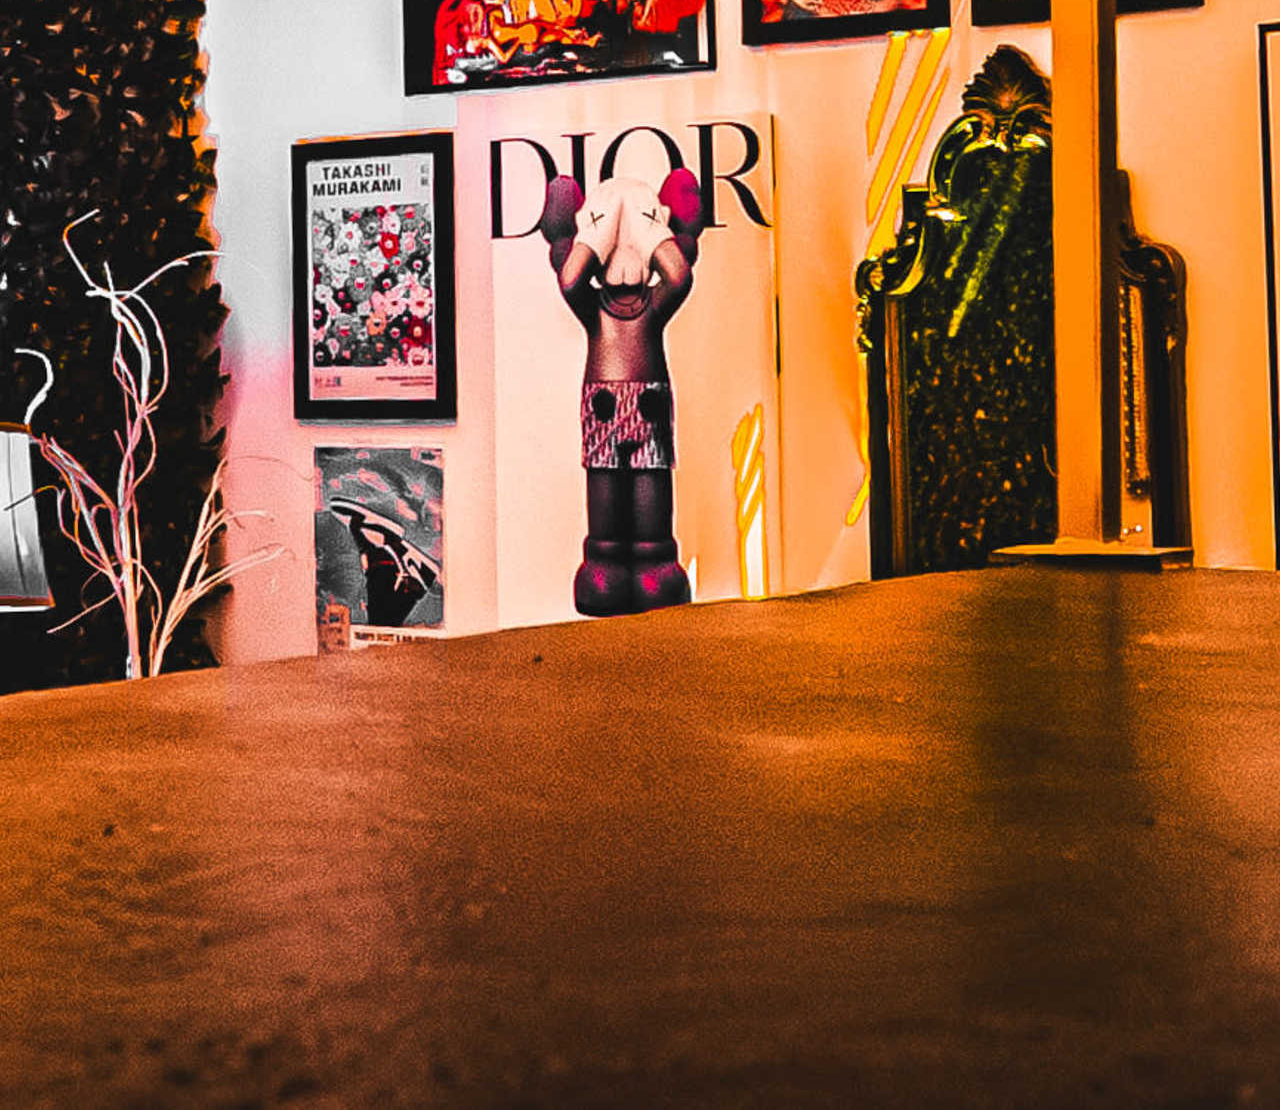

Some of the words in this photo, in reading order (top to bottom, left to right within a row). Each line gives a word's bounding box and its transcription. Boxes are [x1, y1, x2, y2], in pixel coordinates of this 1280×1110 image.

[322, 163, 391, 181] TAKASHI
[490, 121, 773, 239] DIOR
[313, 178, 401, 197] MURAKAMI
